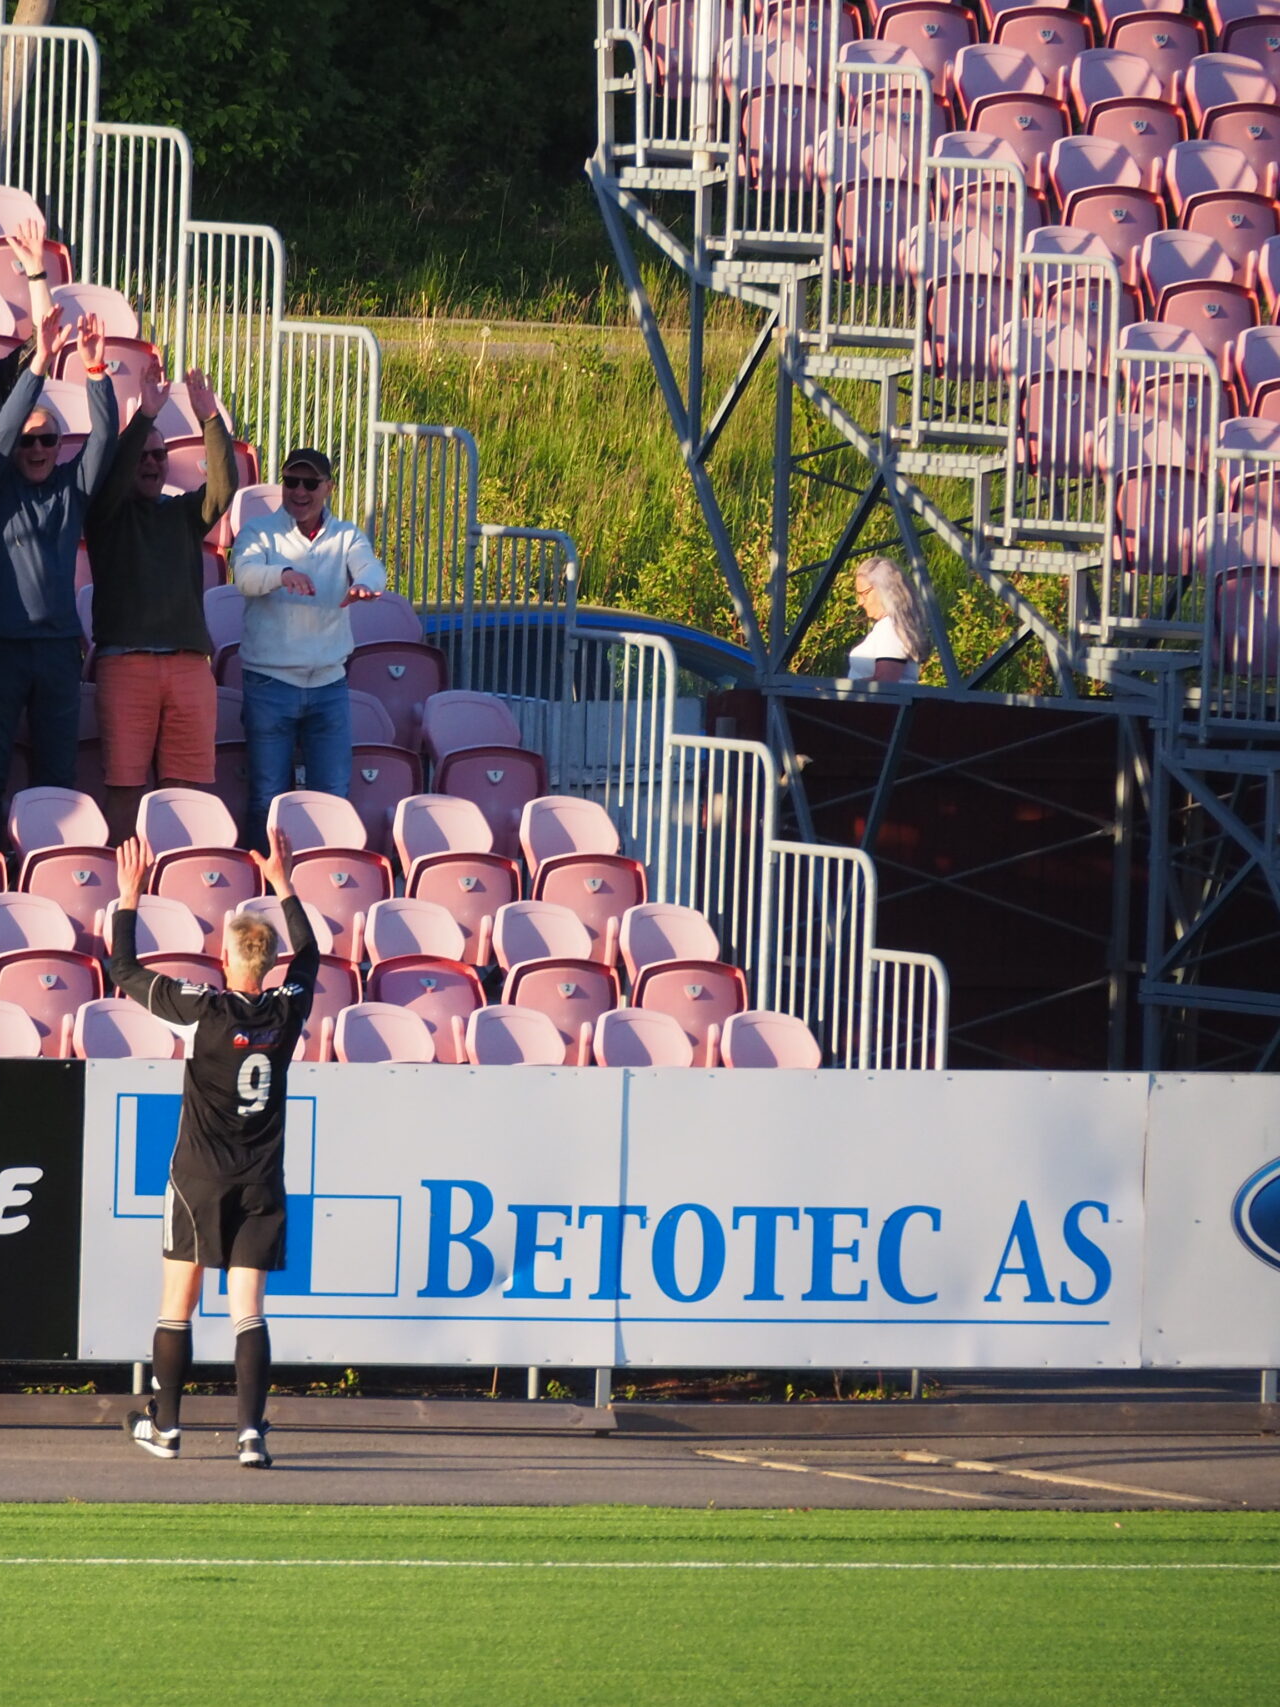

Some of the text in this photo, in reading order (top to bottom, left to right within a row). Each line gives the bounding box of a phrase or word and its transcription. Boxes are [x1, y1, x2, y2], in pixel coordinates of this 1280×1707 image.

[237, 1053, 272, 1117] 9
[416, 1179, 1113, 1306] BETOTEC AS
